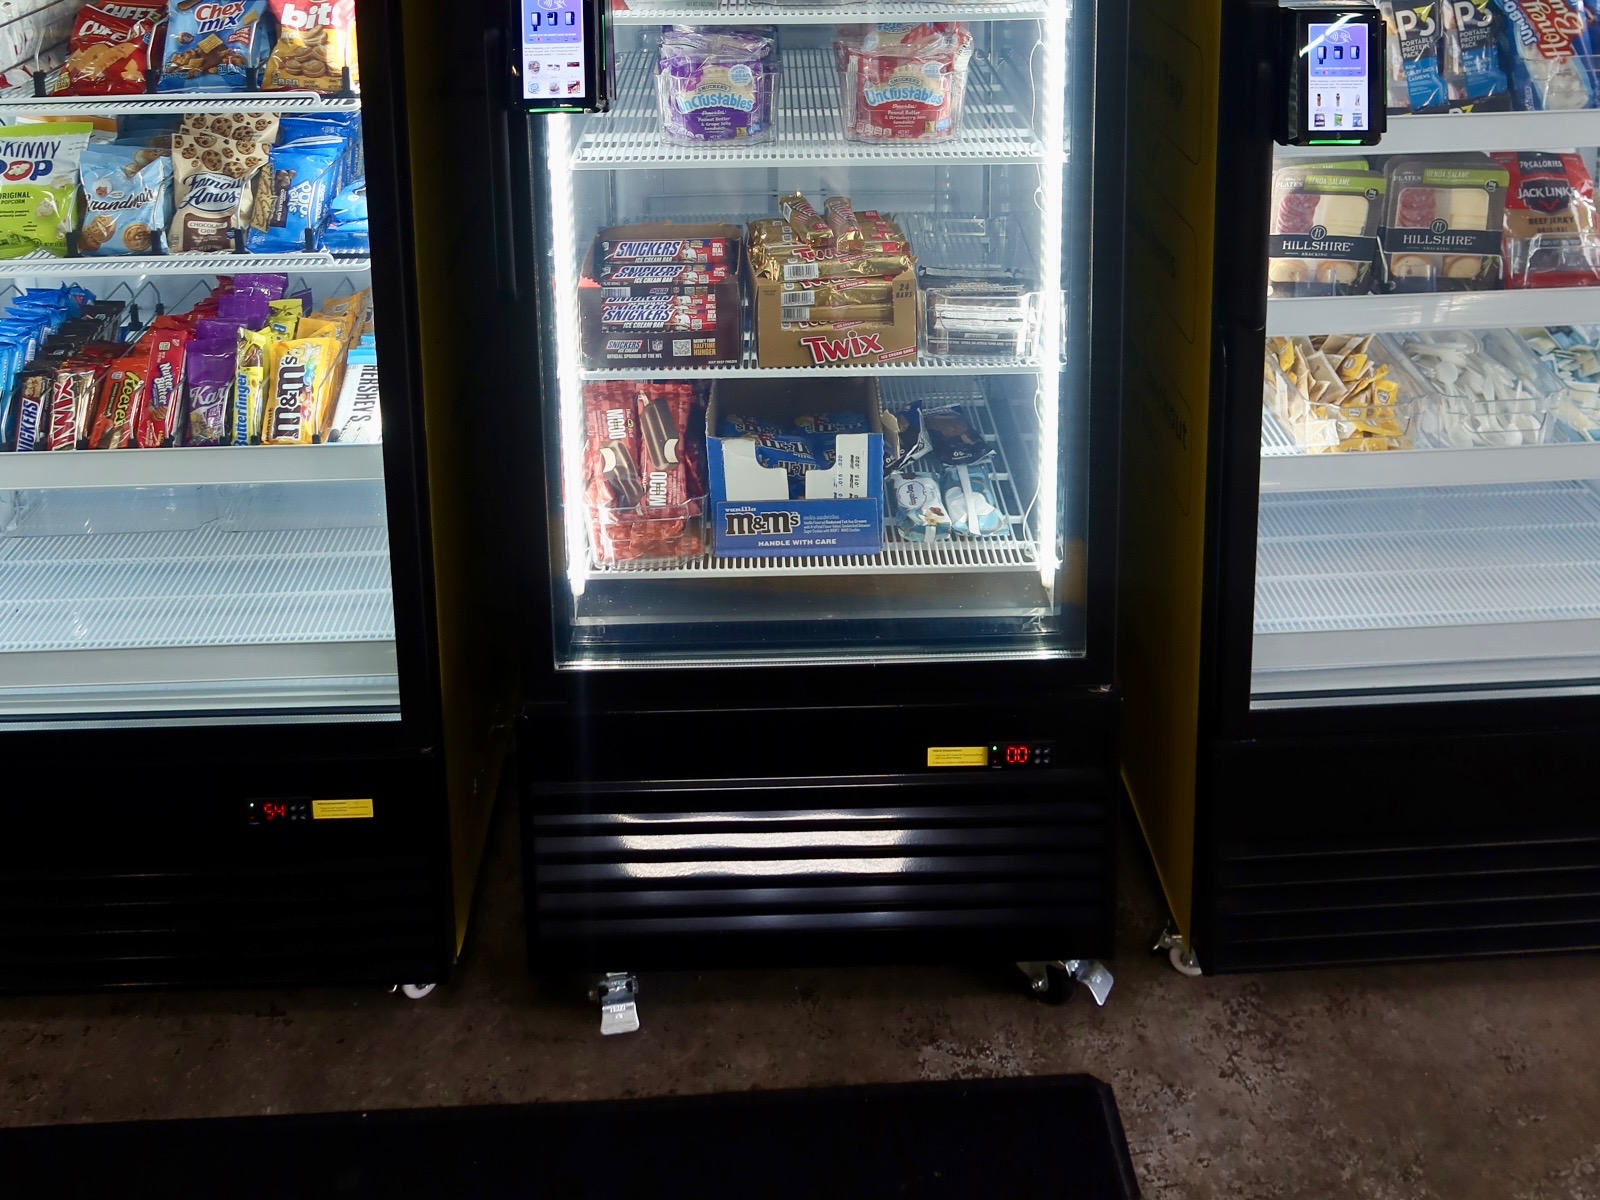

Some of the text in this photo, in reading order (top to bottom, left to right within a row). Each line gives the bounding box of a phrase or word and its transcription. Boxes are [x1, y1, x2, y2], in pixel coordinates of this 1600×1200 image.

[195, 0, 247, 22] Chex
[1504, 0, 1538, 46] JUMBO
[1459, 27, 1490, 38] PORTABLE
[1460, 34, 1487, 43] PROTEIN
[1401, 36, 1434, 47] PORTABLE
[1402, 42, 1430, 54] PROTEIN
[890, 77, 921, 86] SMUCKER'S
[676, 92, 754, 113] Uncrustables
[864, 86, 943, 107] Uncrustables
[179, 188, 240, 210] Amos
[1550, 216, 1574, 224] JERKY
[1282, 240, 1351, 252] HILLSHIRE
[1403, 234, 1473, 246] HILLSHIRE
[616, 242, 680, 256] SNICKERS
[614, 266, 683, 278] SNICKERS
[899, 283, 909, 291] 24
[603, 310, 672, 321] SNICKERS
[608, 341, 641, 349] SNICKERS
[801, 330, 884, 364] Twix
[233, 372, 248, 446] Butterfinger
[18, 399, 39, 452] NICKERS
